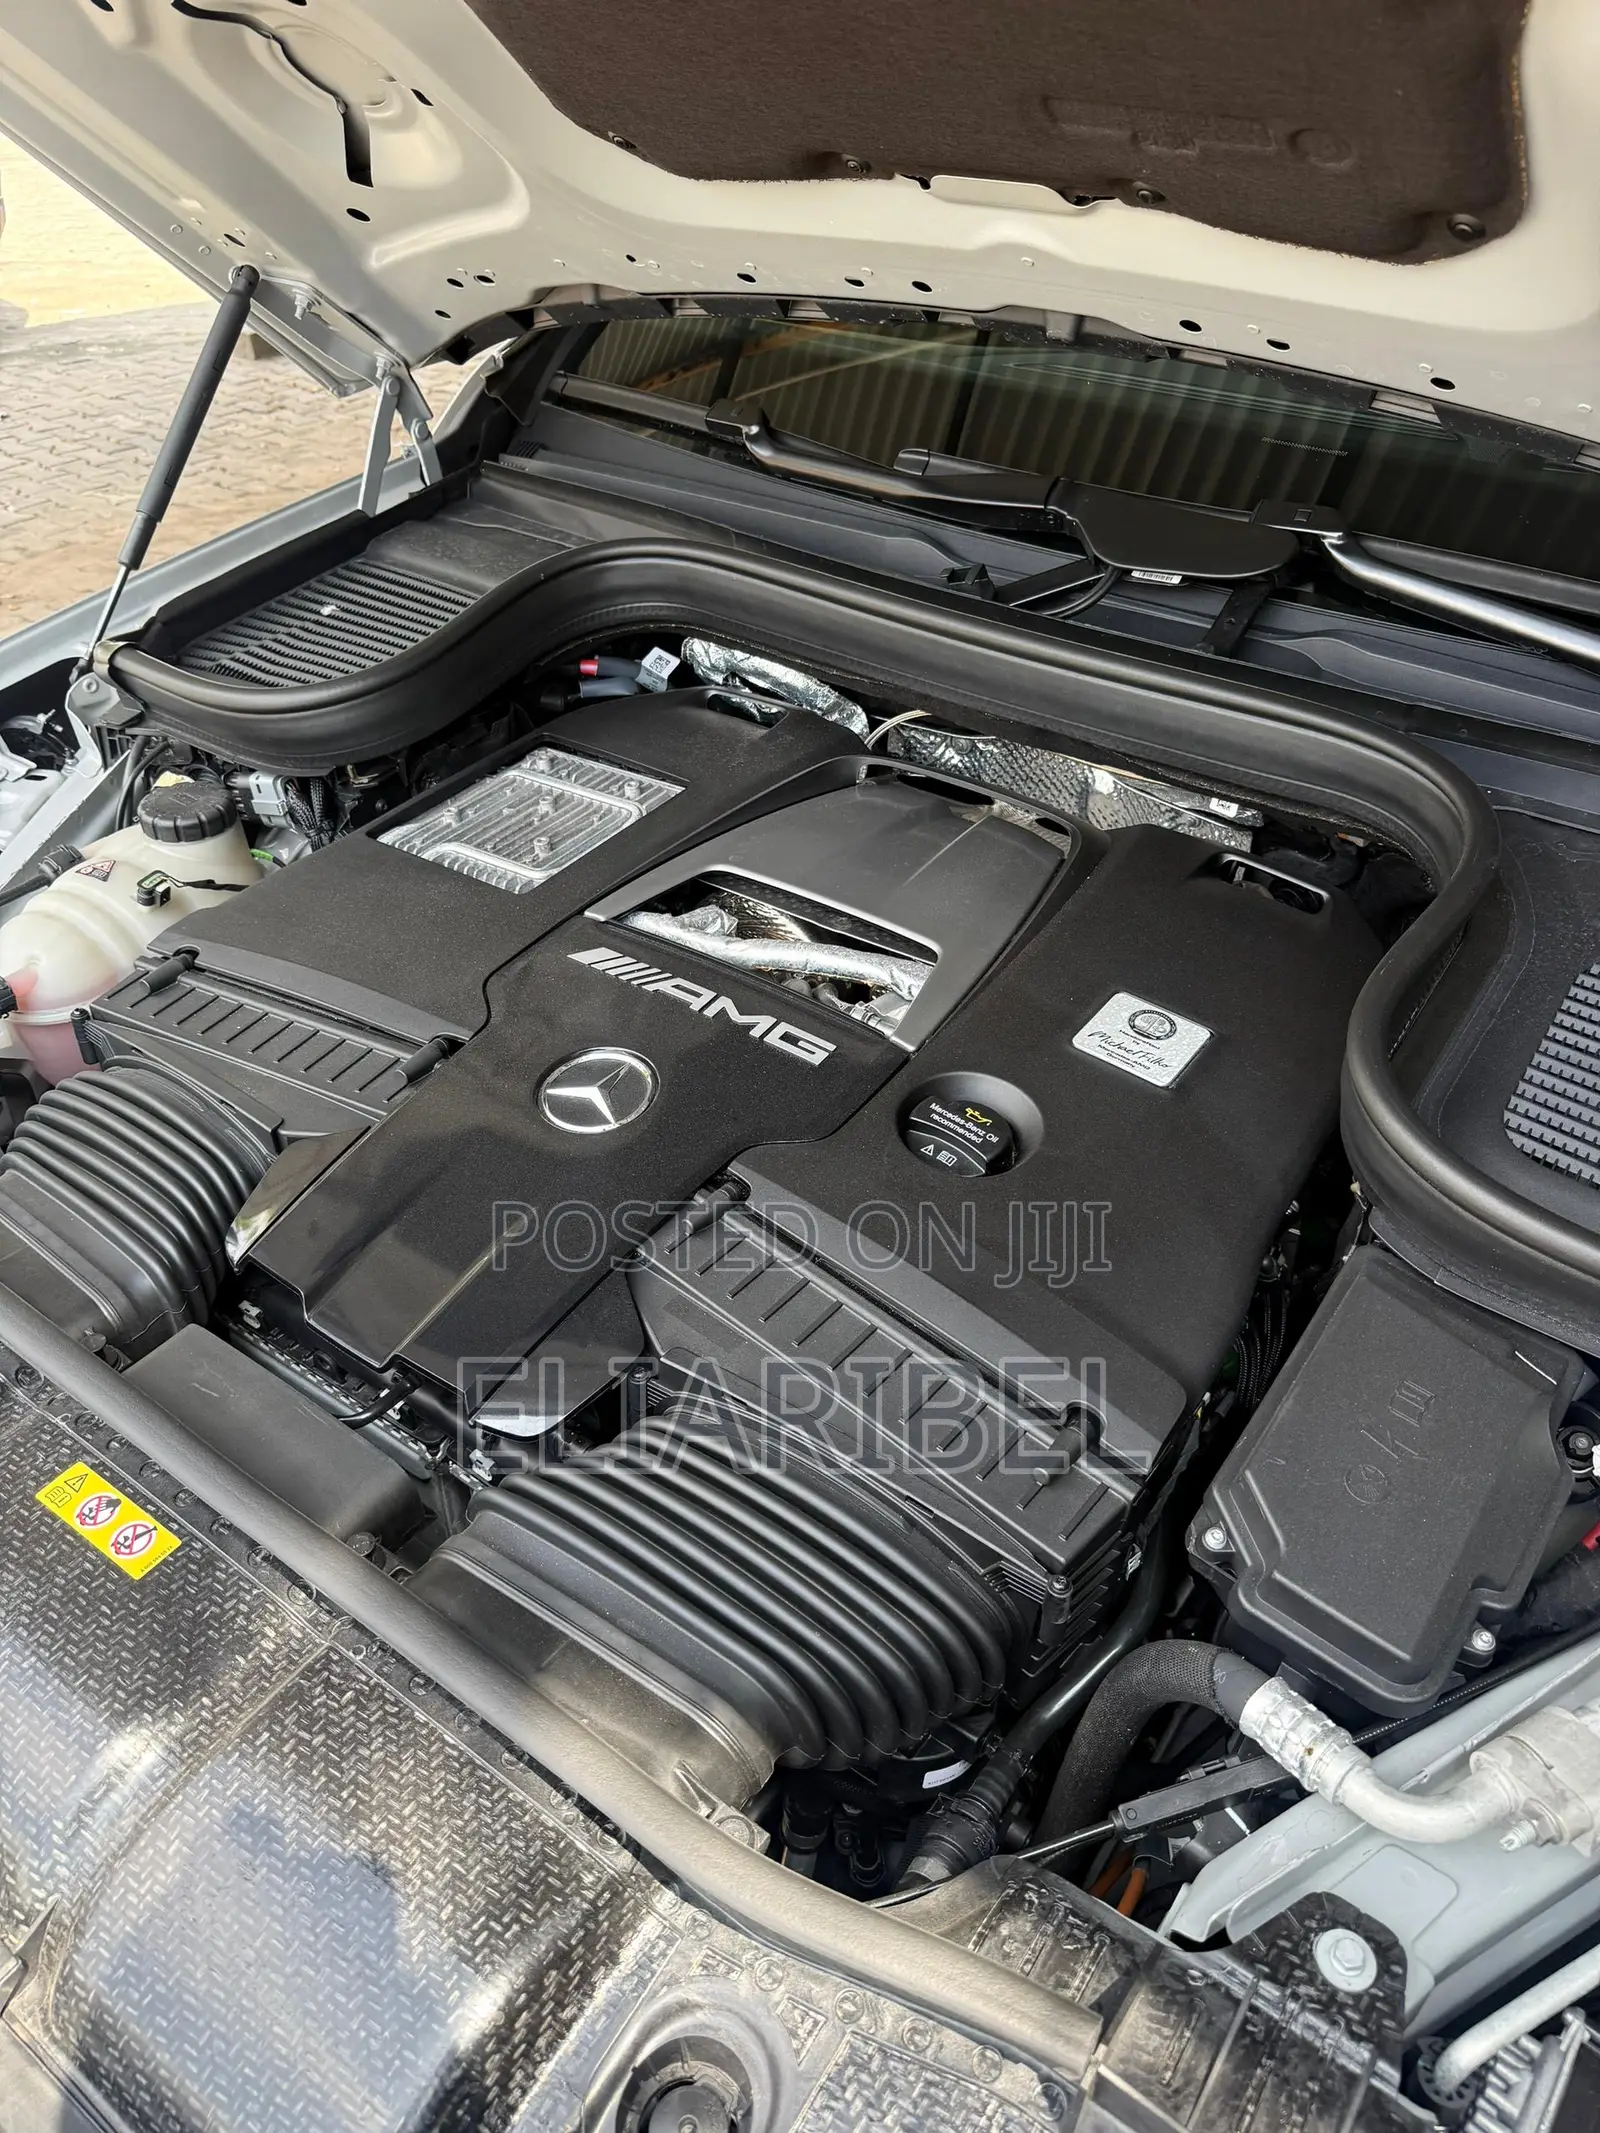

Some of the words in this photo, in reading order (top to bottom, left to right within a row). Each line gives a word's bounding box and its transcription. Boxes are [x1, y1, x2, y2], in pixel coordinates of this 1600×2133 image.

[640, 975, 838, 1066] AMG
[1087, 1030, 1143, 1056] Michael
[929, 1102, 986, 1136] Mercedes-Benz
[986, 1131, 1000, 1144] Oil
[930, 1112, 983, 1144] recommended
